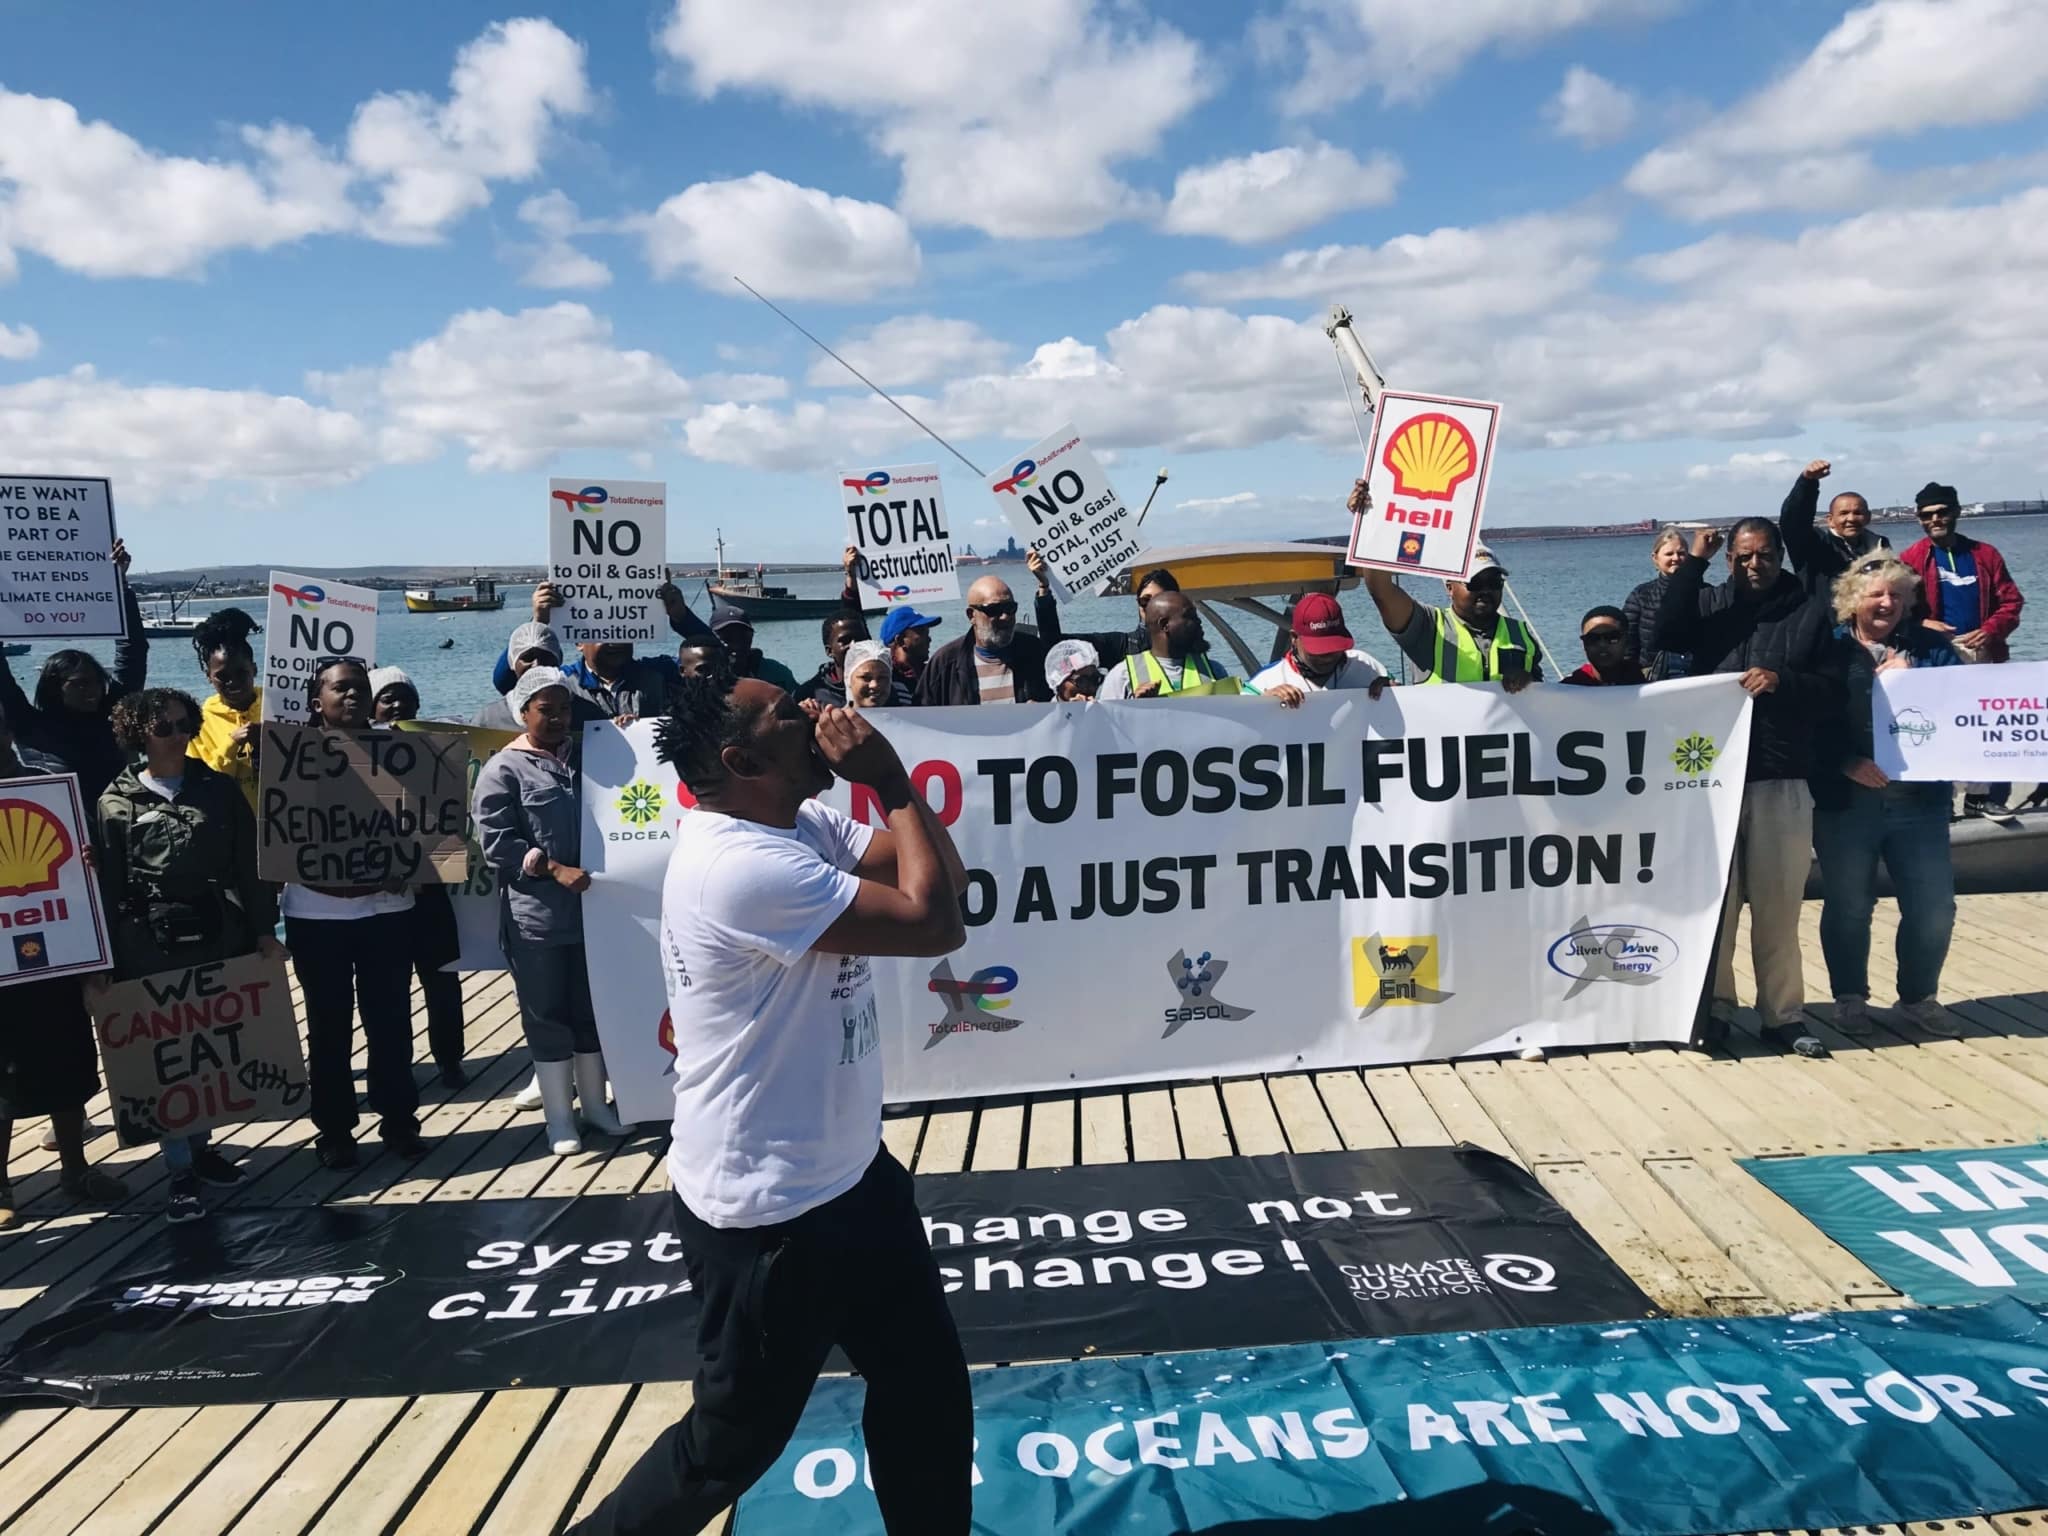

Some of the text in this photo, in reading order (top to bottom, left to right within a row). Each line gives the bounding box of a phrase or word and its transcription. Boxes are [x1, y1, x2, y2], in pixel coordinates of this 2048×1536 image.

[0, 486, 88, 501] WE WANT
[609, 495, 664, 507] TotalEnergies
[1022, 469, 1084, 525] NO
[4, 506, 80, 521] TO BE A
[848, 497, 949, 548] TOTAL
[1030, 488, 1116, 552] to Oil & Gas!
[1089, 506, 1128, 537] move
[1385, 501, 1453, 530] hell
[8, 528, 79, 541] PART OF
[573, 519, 641, 556] NO
[17, 550, 106, 562] GENERATION
[1062, 528, 1124, 576] to a JUST
[554, 563, 662, 579] to Oil & Gas!
[858, 543, 954, 581] Destruction!
[1065, 540, 1140, 595] Transition!
[12, 571, 89, 582] THAT ENDS
[0, 591, 113, 603] LIMATE CHANGE
[618, 587, 664, 599] move
[24, 612, 85, 623] DO YOU?
[570, 605, 648, 620] to a JUST
[290, 614, 354, 655] NO
[563, 625, 655, 640] Transition!
[270, 655, 315, 673] to Oil
[266, 673, 309, 691] TOTA
[283, 697, 300, 711] to
[1978, 697, 2048, 711] TOTAL
[1955, 713, 2039, 727] OIL AND
[1983, 730, 2003, 742] IN
[269, 730, 349, 782] YES
[358, 735, 417, 777] TO
[977, 755, 1079, 826] TO
[1096, 743, 1346, 820] FOSSIL
[1362, 730, 1607, 804] FUELS
[1664, 779, 1722, 791] SDCEA
[608, 830, 671, 841] SDCEA
[960, 867, 999, 928] O
[1013, 866, 1058, 924] A
[1070, 854, 1217, 921] JUST
[1237, 833, 1623, 906] TRANSITION
[1565, 939, 1659, 956] Silver Wave
[1612, 961, 1653, 973] Energy
[142, 962, 228, 1007] WE
[100, 981, 270, 1049] CANNOT
[928, 1018, 1018, 1034] TotalEnergies
[154, 1022, 244, 1085] EAT
[466, 1190, 1412, 1276] Syst hange not
[1339, 1258, 1474, 1278] CLIMATE
[1349, 1271, 1486, 1291] JUSTICE
[428, 1278, 693, 1320] clim
[1352, 1285, 1494, 1301] COALITION
[1017, 1407, 1369, 1480] OCEANS
[1407, 1393, 1587, 1451] ARE
[1595, 1381, 1790, 1438] NOT
[1803, 1370, 2014, 1425] FOR
